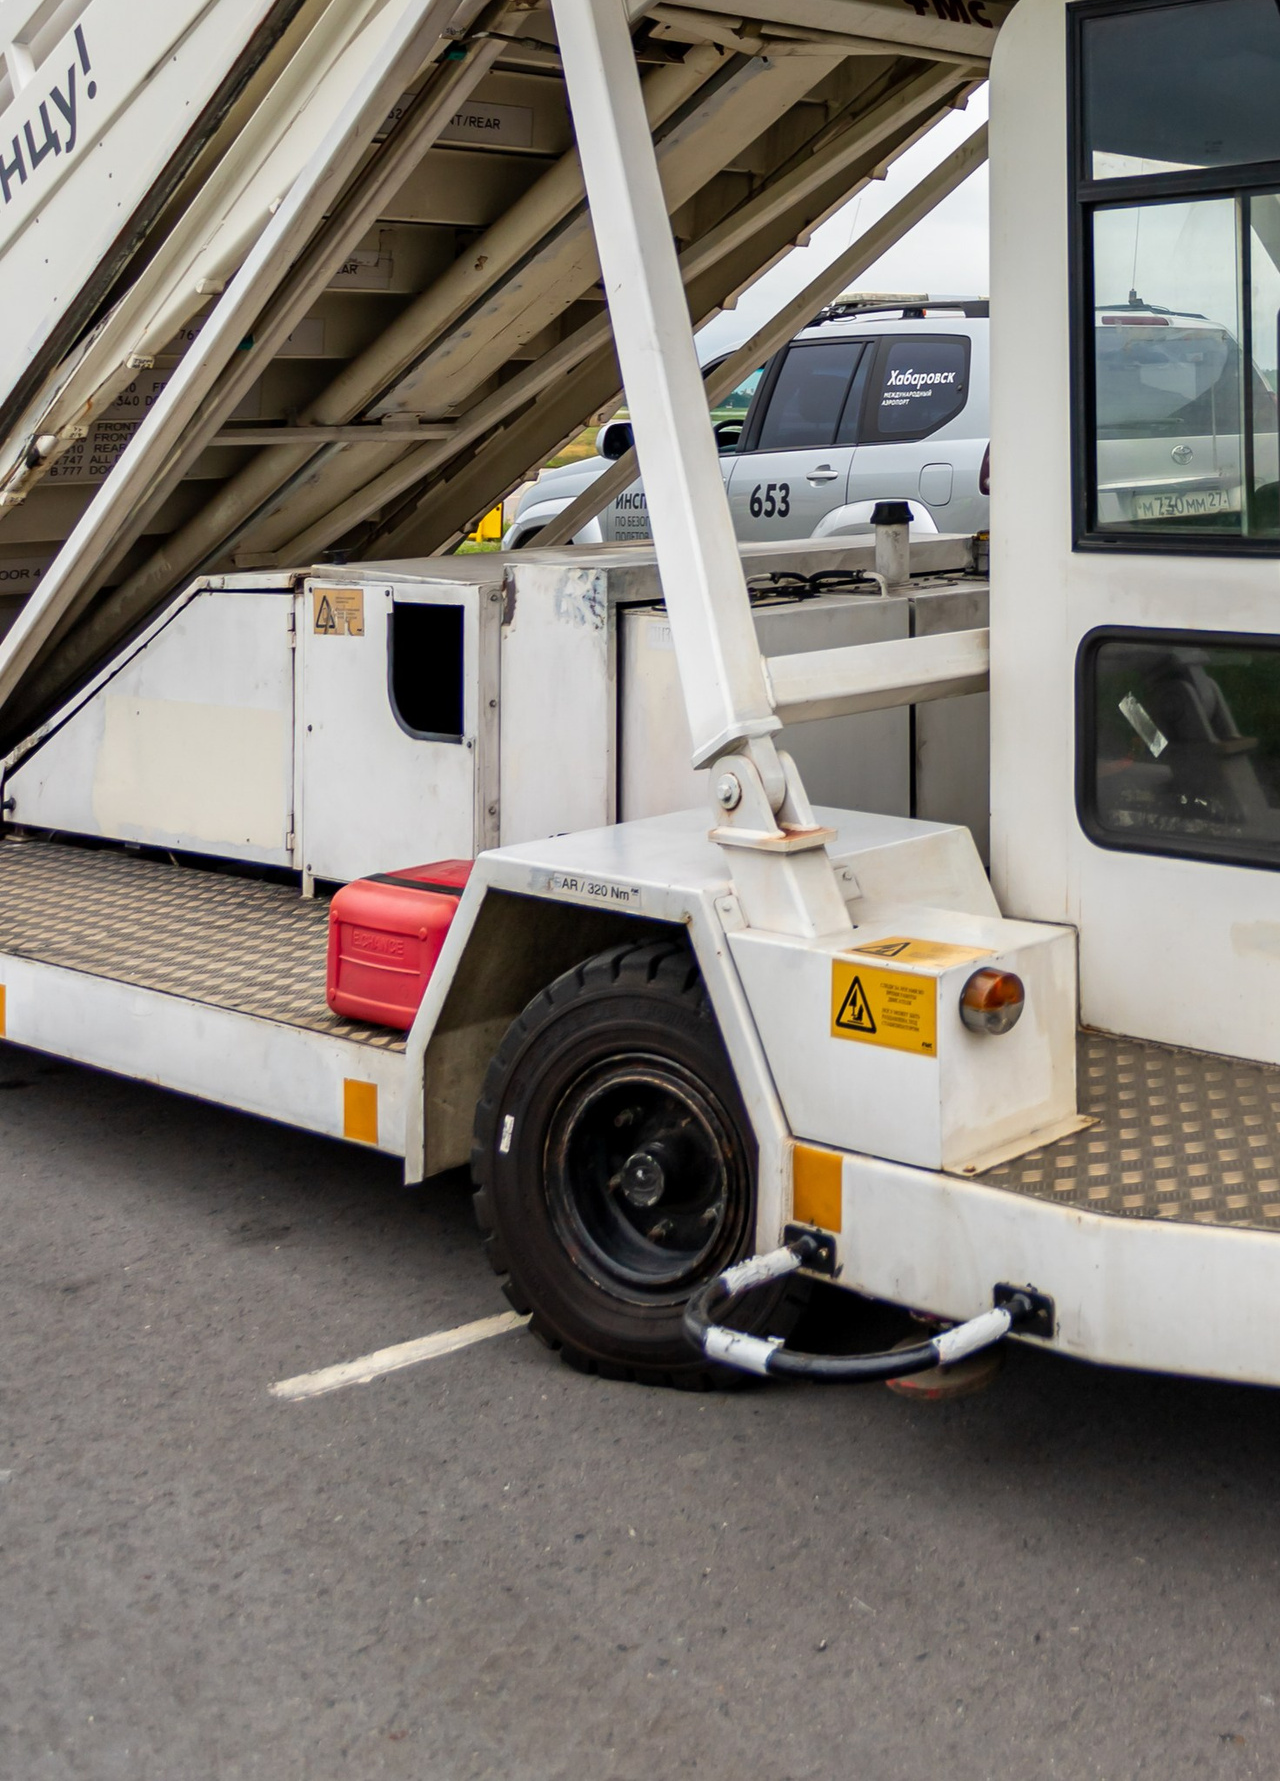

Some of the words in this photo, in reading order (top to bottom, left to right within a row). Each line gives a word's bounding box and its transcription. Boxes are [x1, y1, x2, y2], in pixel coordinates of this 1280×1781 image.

[0, 23, 97, 204] нцу!
[887, 369, 956, 389] Хабаровск
[883, 389, 932, 399] МЕЖДУНАРОДНЫЙ
[881, 398, 910, 406] АЭРОПОРТ
[90, 455, 111, 464] ALL
[50, 466, 83, 477] B.777
[750, 482, 790, 518] 653
[615, 516, 626, 527] ПО
[588, 883, 608, 897] 320
[611, 886, 630, 900] Nm
